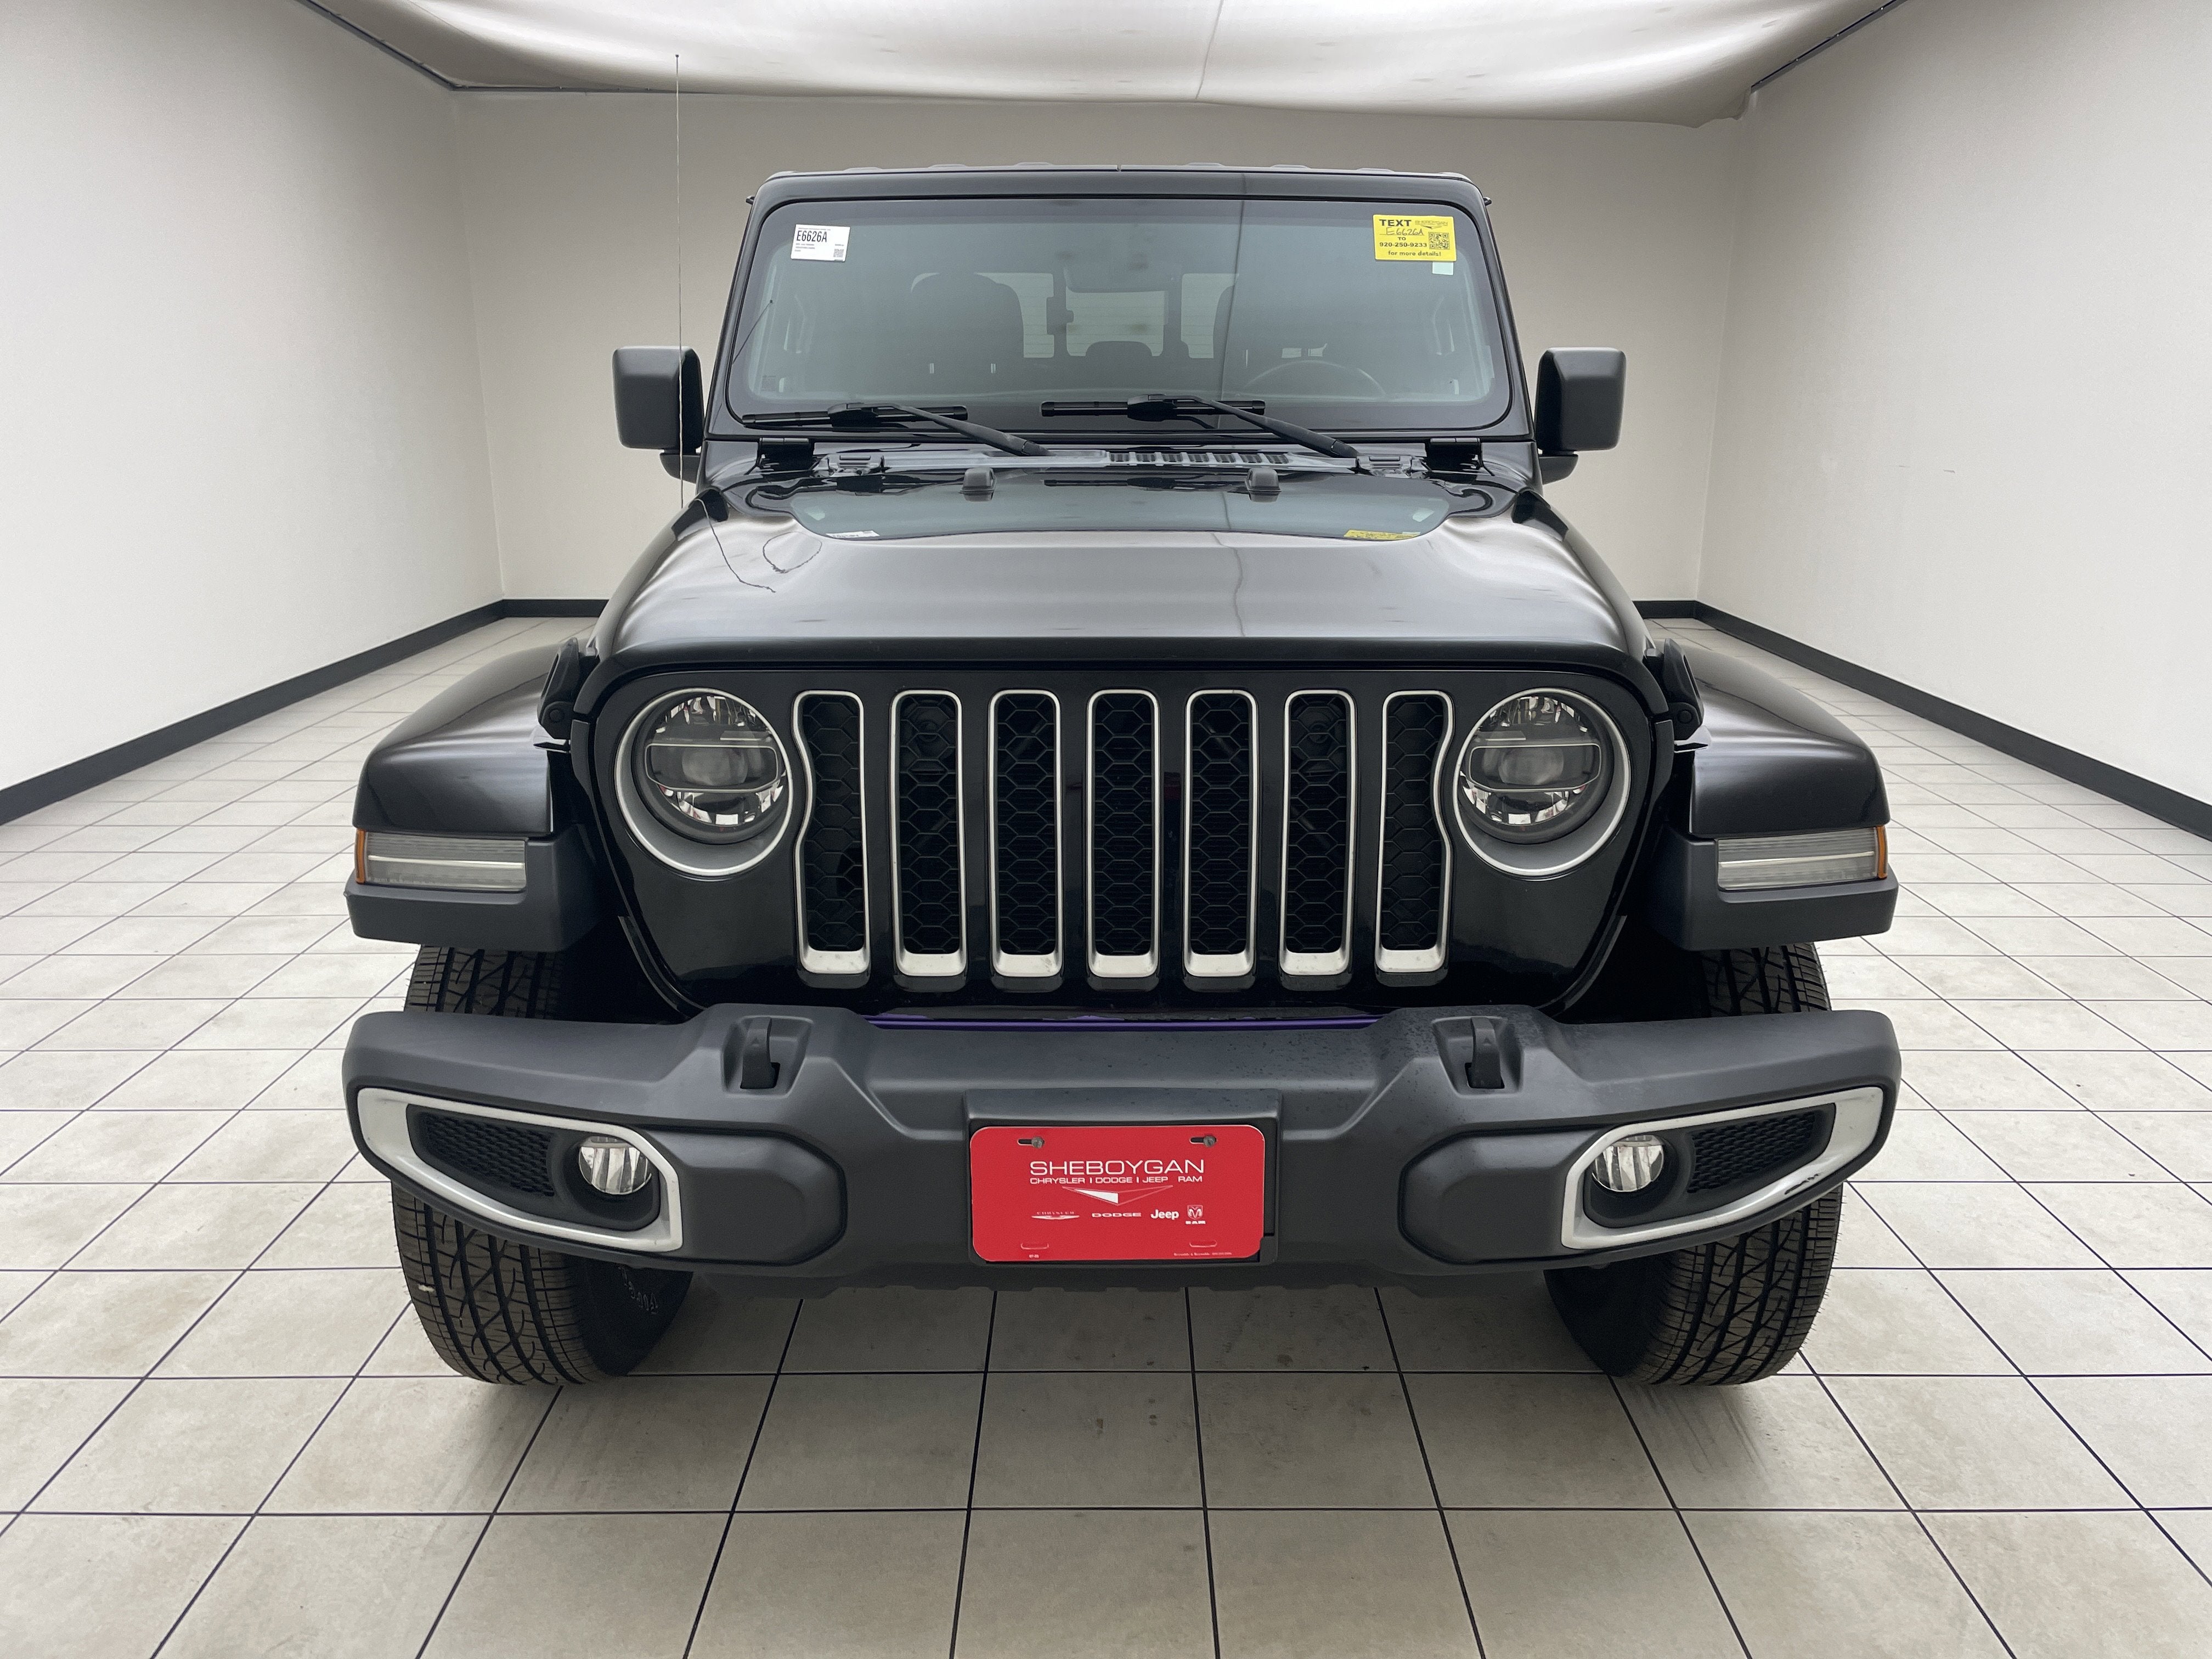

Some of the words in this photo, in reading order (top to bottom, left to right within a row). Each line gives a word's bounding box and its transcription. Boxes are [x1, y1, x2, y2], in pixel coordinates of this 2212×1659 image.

[797, 230, 827, 242] E6626A
[1386, 227, 1424, 235] E6626A
[1030, 1159, 1204, 1176] SHEBOYGAN
[1150, 1209, 1180, 1220] Jeep
